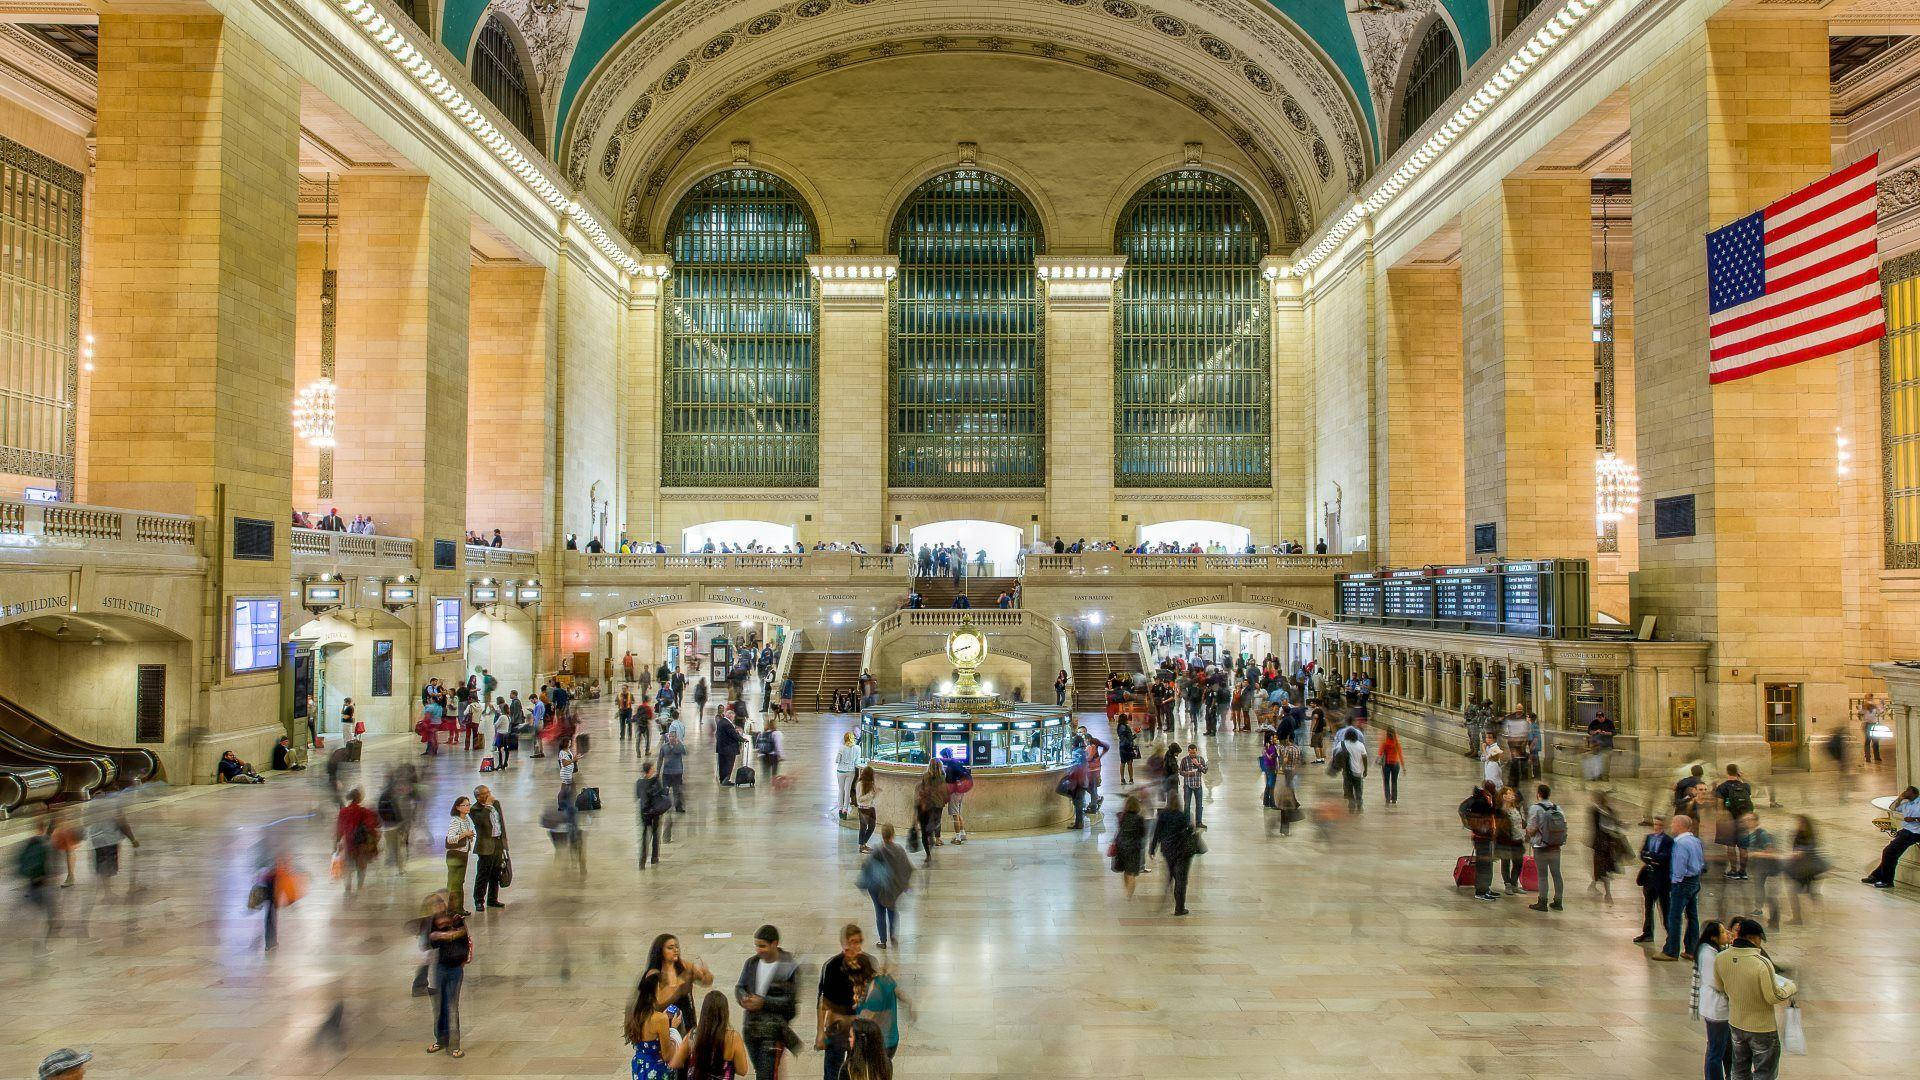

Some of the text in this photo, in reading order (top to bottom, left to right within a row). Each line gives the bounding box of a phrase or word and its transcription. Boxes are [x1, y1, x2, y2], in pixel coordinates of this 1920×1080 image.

[15, 595, 68, 614] BUILDING
[102, 597, 162, 618] 45TH STREET
[708, 594, 766, 608] LEXINGTON AVE
[1167, 595, 1209, 609] LEXINGTON
[1250, 594, 1314, 610] TICKET MACHINES
